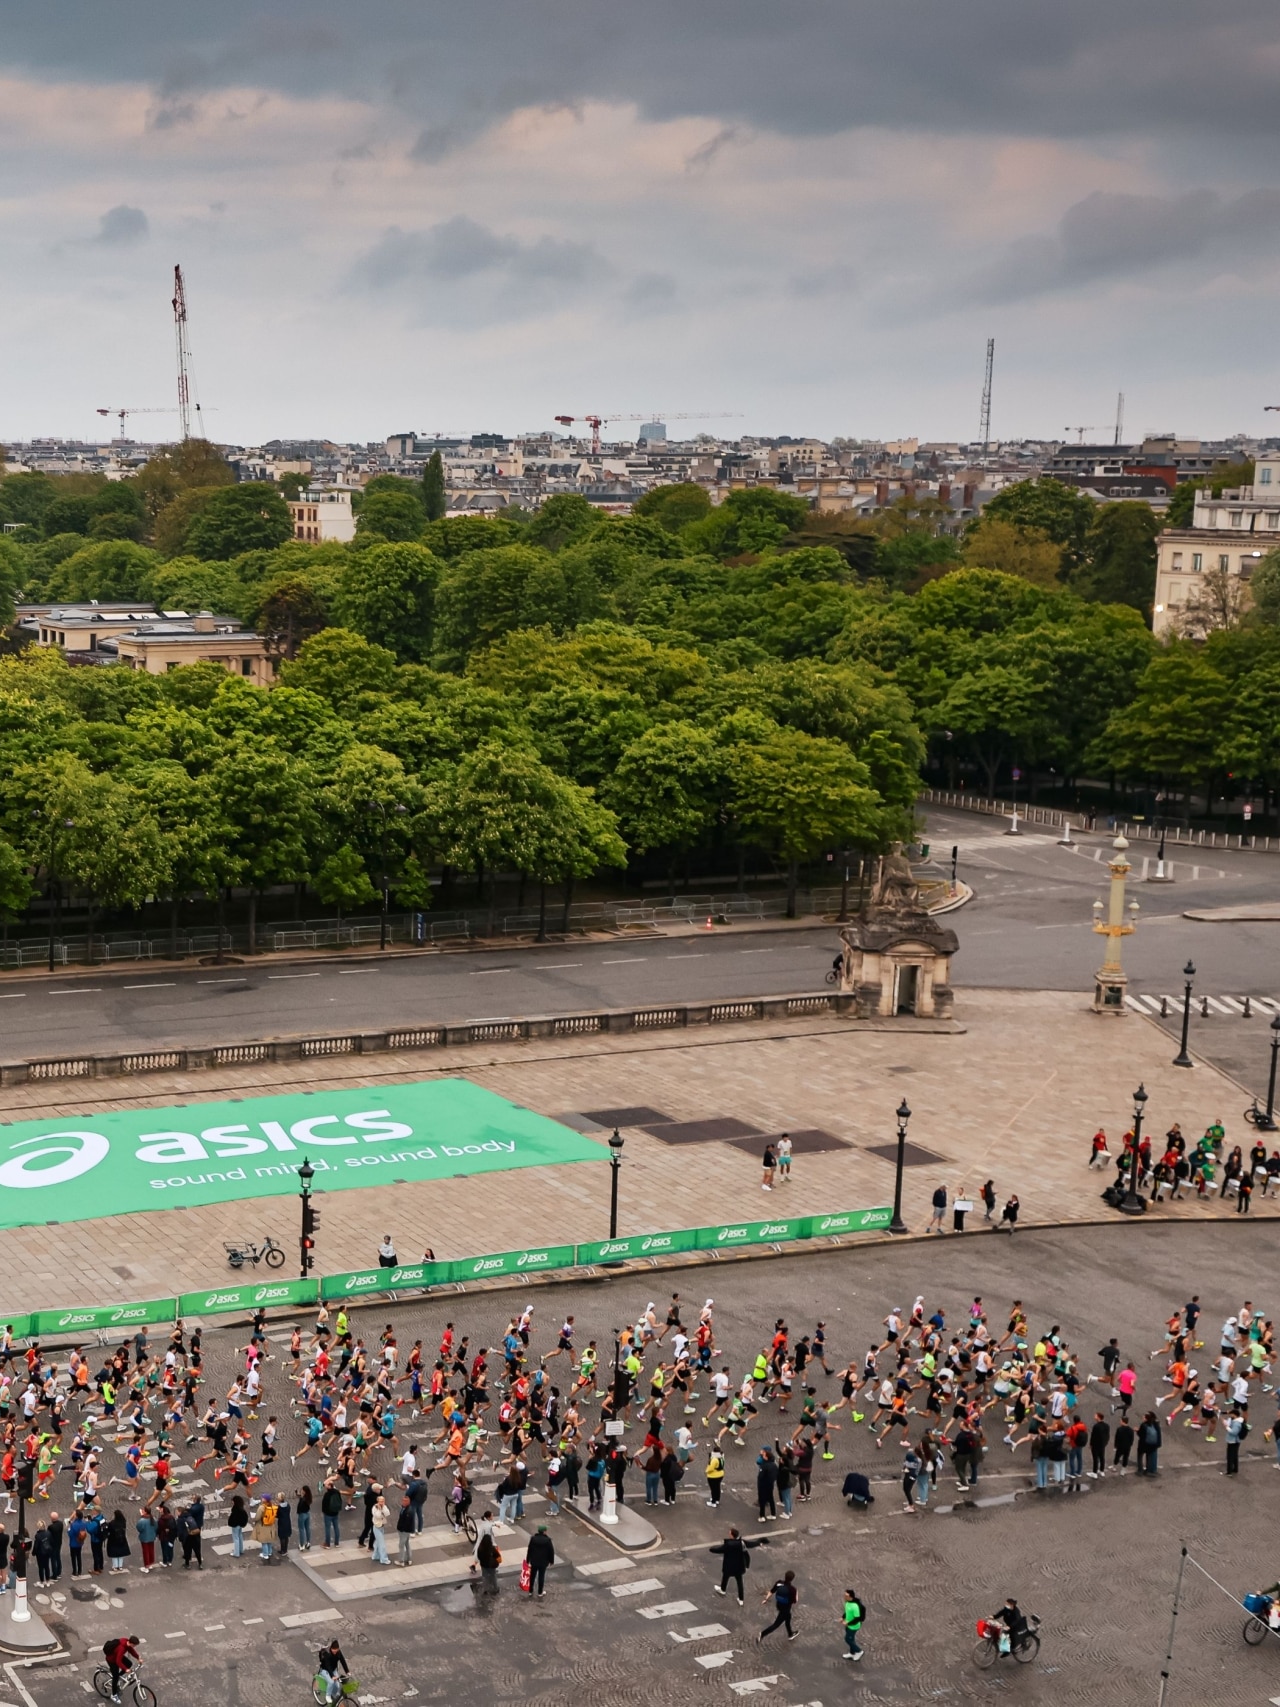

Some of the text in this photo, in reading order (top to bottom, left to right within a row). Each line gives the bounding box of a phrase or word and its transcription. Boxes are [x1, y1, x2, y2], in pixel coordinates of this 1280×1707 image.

[136, 1110, 413, 1164] asics
[149, 1168, 247, 1189] sound
[345, 1147, 437, 1167] sound
[441, 1140, 516, 1157] body
[828, 1217, 850, 1226] asics
[869, 1212, 889, 1222] asics
[726, 1229, 747, 1239] asics
[767, 1225, 788, 1235] asics
[650, 1237, 671, 1247] asics
[609, 1243, 629, 1252] asics
[526, 1253, 548, 1263] asics
[482, 1259, 503, 1269] asics
[402, 1270, 424, 1280] asics
[356, 1276, 378, 1286] asics
[266, 1288, 289, 1298] asics
[217, 1294, 239, 1304] asics
[71, 1314, 95, 1323] asics
[123, 1309, 147, 1318] asics
